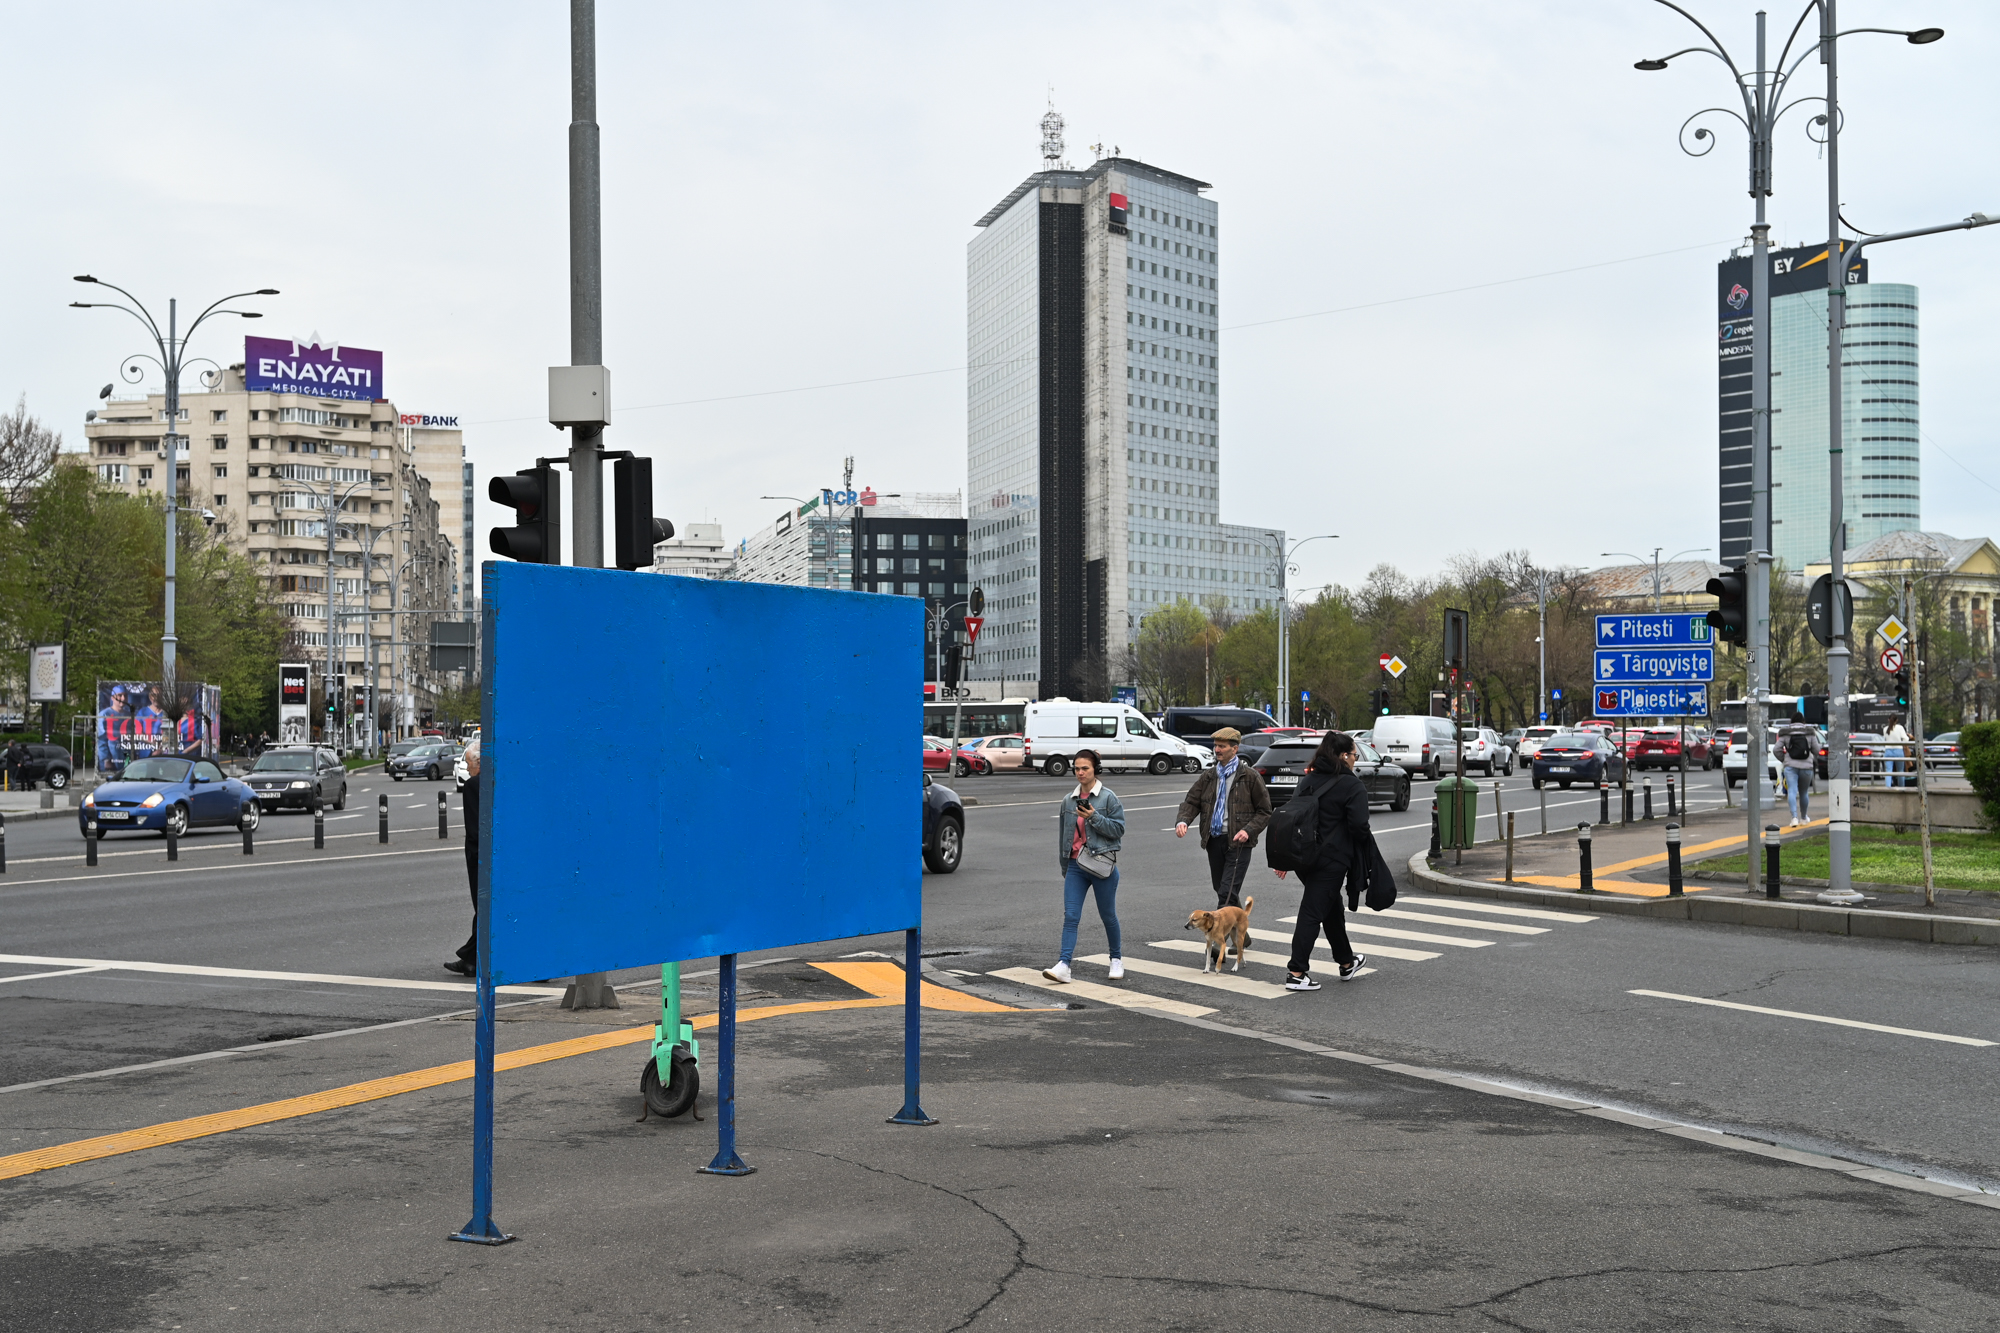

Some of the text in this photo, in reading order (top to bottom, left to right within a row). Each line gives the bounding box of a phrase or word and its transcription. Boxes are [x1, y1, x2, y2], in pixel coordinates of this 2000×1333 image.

[1108, 223, 1128, 236] BRD
[1774, 257, 1794, 275] EY
[1848, 271, 1859, 284] EY
[1733, 324, 1753, 336] cegek
[1719, 344, 1753, 356] MINDSPAC
[259, 358, 371, 387] ENAYATI
[272, 383, 357, 399] MEDICAL CITY
[400, 414, 459, 427] RSTBANK
[1621, 619, 1673, 640] Pitești
[1621, 653, 1708, 677] Târgoviște
[284, 678, 304, 686] Net
[284, 686, 304, 694] Bet
[941, 688, 971, 698] BRD
[105, 709, 195, 742] totl
